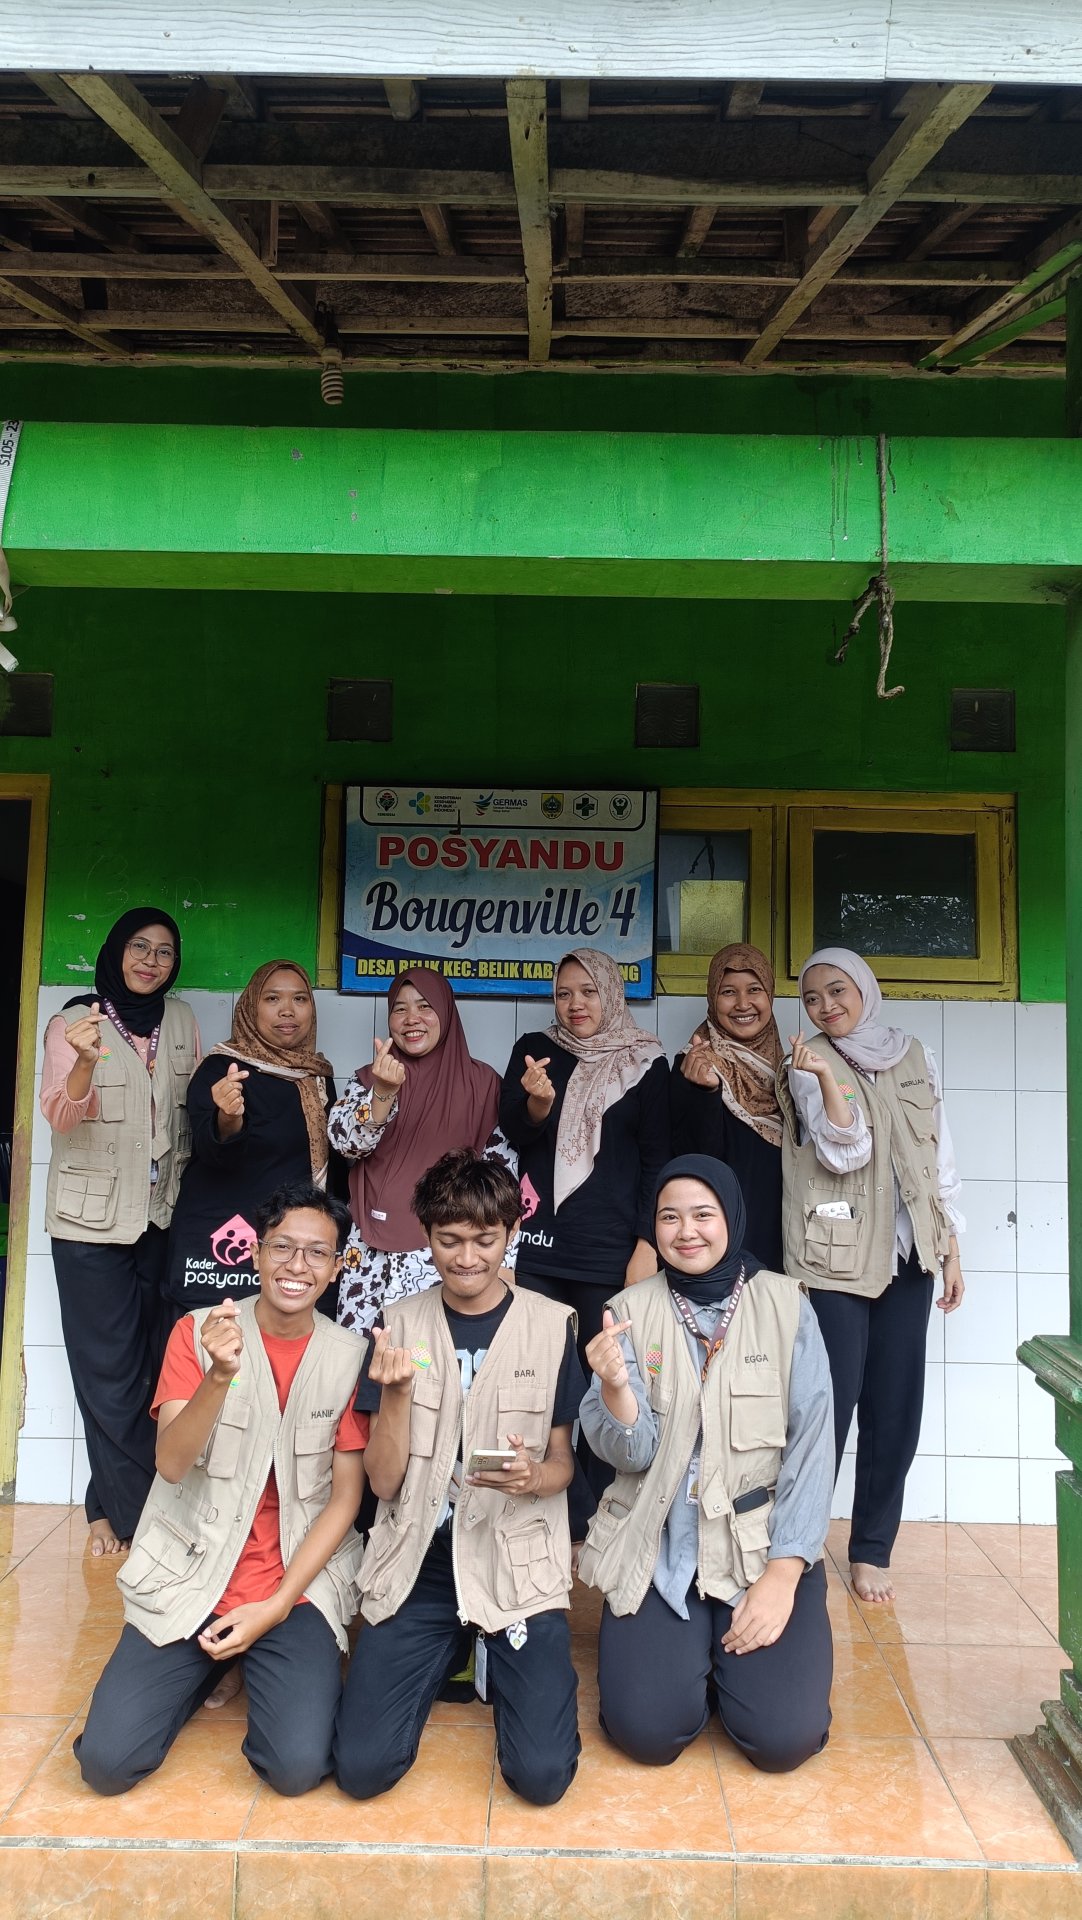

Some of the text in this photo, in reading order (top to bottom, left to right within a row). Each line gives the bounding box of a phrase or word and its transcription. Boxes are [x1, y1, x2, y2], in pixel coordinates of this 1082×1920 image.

[493, 799, 528, 807] GERMAS
[379, 836, 624, 871] POSYANDU
[366, 881, 637, 949] Bougenville 4
[357, 959, 396, 975] DESA
[478, 962, 520, 978] BELIK
[186, 1257, 218, 1270] Kader
[721, 1312, 732, 1328] KKN
[729, 1289, 741, 1310] DESA
[744, 1354, 769, 1364] EGGA
[514, 1369, 536, 1378] BARA
[311, 1409, 335, 1419] HANIF
